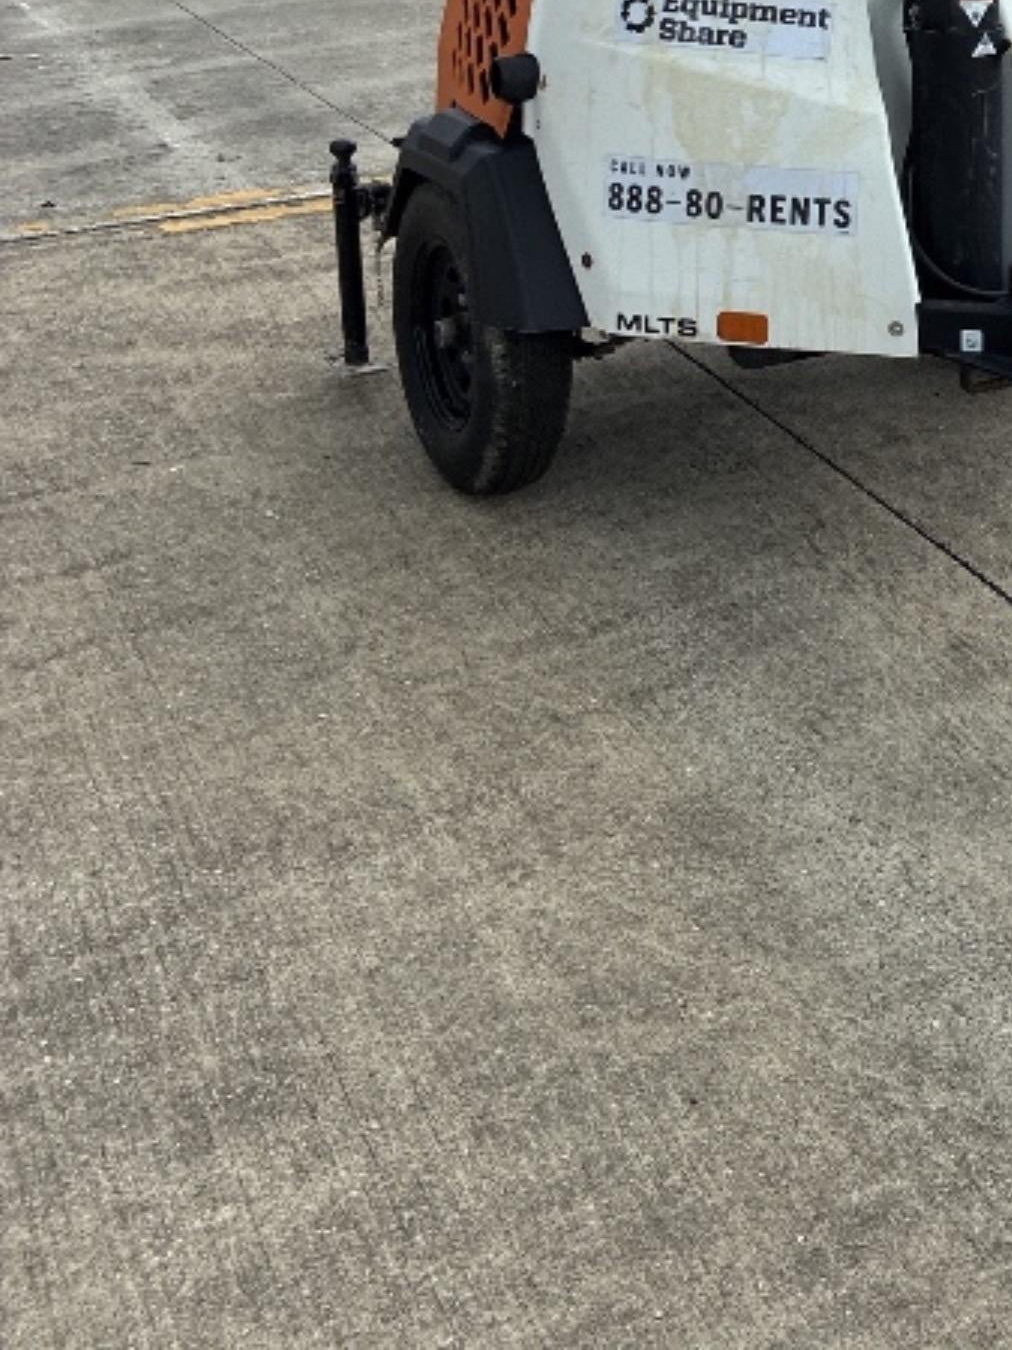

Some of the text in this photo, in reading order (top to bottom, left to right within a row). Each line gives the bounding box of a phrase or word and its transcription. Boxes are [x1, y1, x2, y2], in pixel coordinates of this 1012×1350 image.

[658, 17, 747, 48] Share
[608, 182, 852, 230] 888-80-RENTS
[616, 312, 698, 338] MLTS
